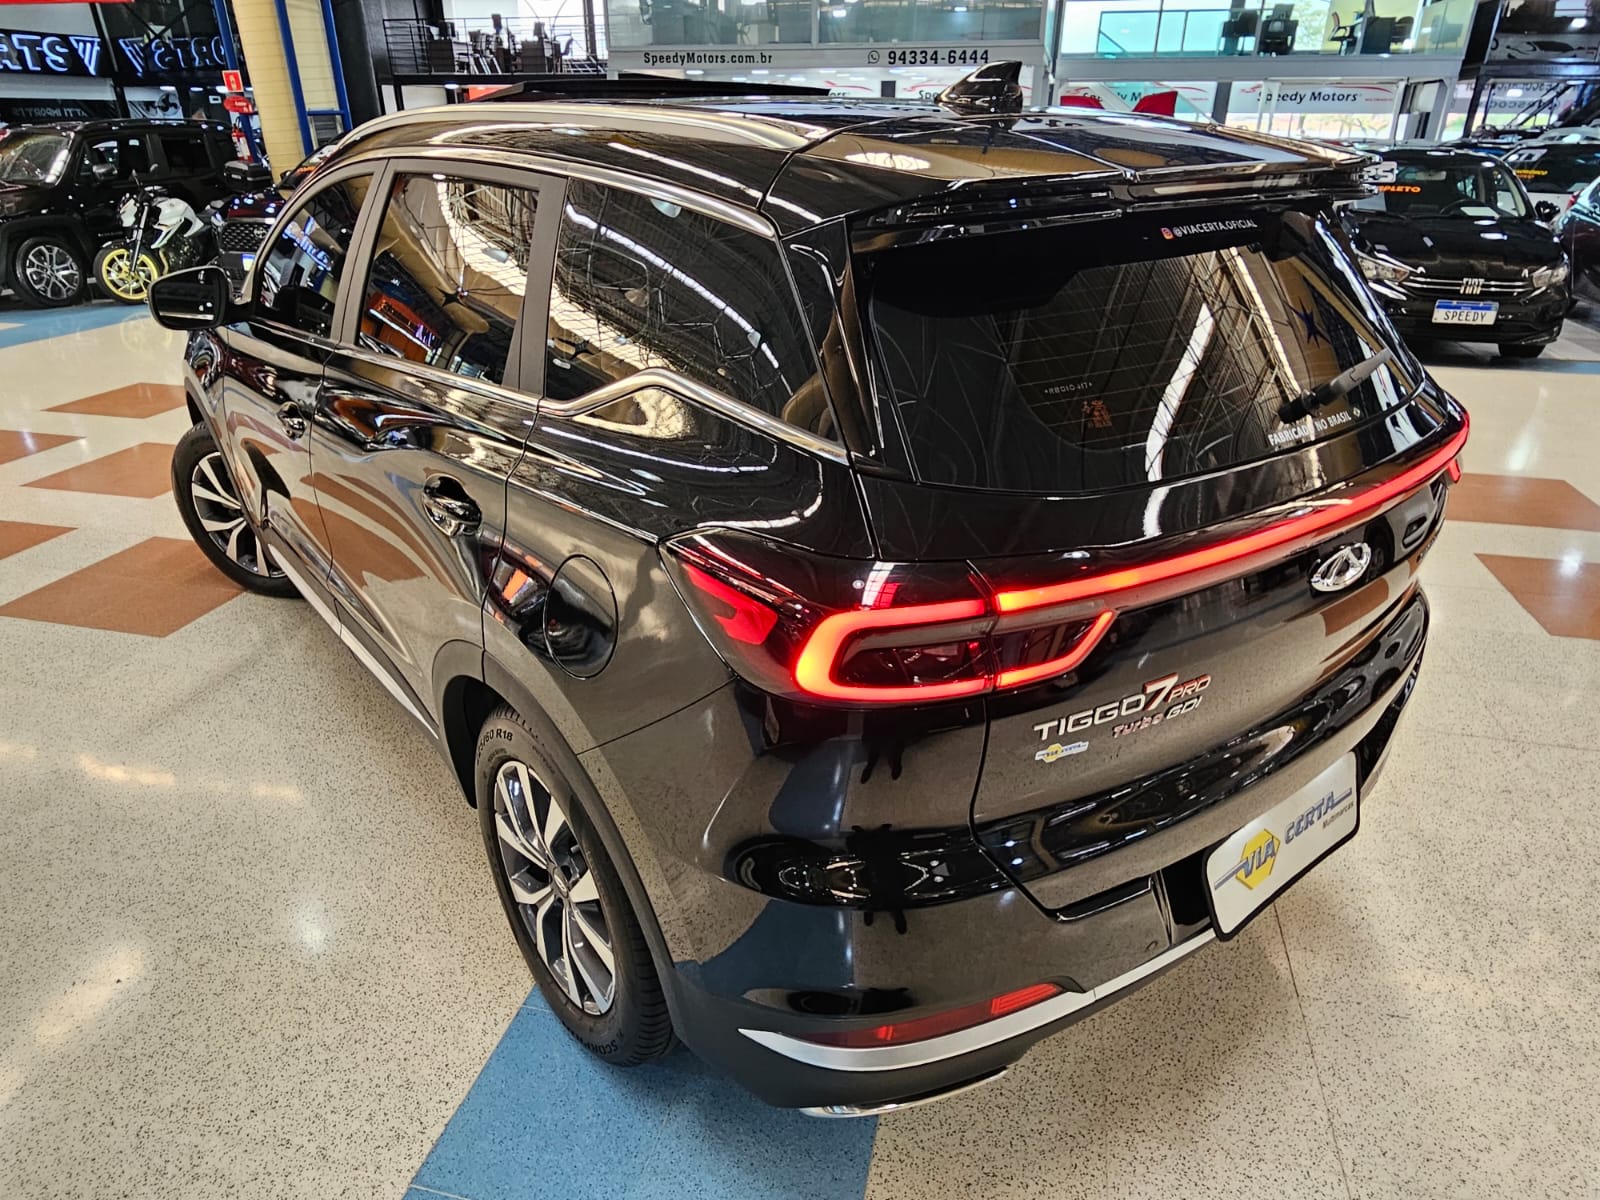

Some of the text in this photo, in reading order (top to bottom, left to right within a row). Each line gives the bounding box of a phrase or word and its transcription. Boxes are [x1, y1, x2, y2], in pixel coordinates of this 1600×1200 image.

[643, 52, 773, 66] SpeedyMotors.com.br
[888, 49, 989, 65] 94334-6444
[1309, 91, 1359, 102] Motors
[1443, 310, 1488, 322] SPEEDY
[1315, 420, 1328, 431] NO
[1328, 411, 1352, 427] BRASIL
[1033, 672, 1212, 741] TIGGO 7 PRO
[1165, 696, 1203, 720] GDI
[496, 728, 513, 742] R18
[1241, 791, 1337, 879] VIA CERTA
